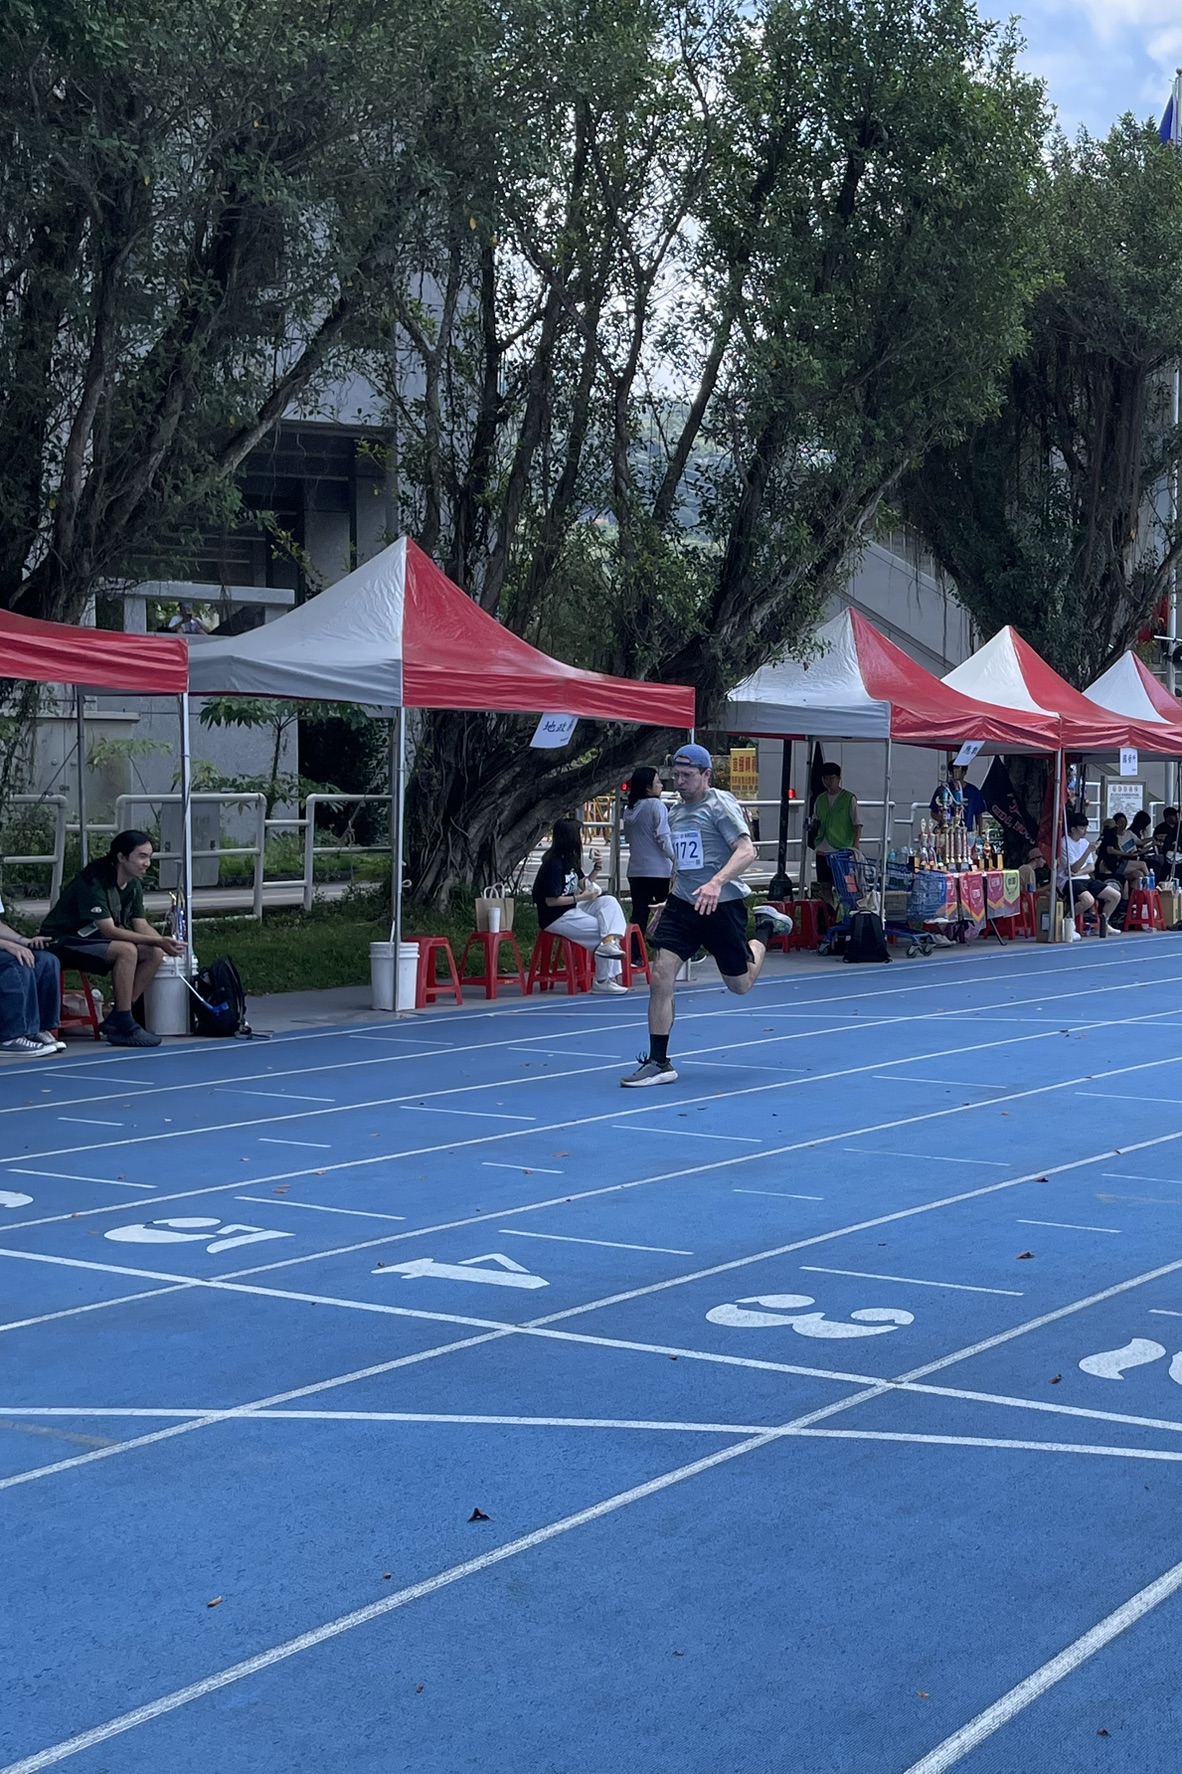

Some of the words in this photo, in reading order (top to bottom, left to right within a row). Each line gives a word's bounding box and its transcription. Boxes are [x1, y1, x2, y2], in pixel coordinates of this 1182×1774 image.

[104, 1217, 297, 1254] 5
[370, 1252, 551, 1290] 4
[706, 1294, 916, 1339] 3
